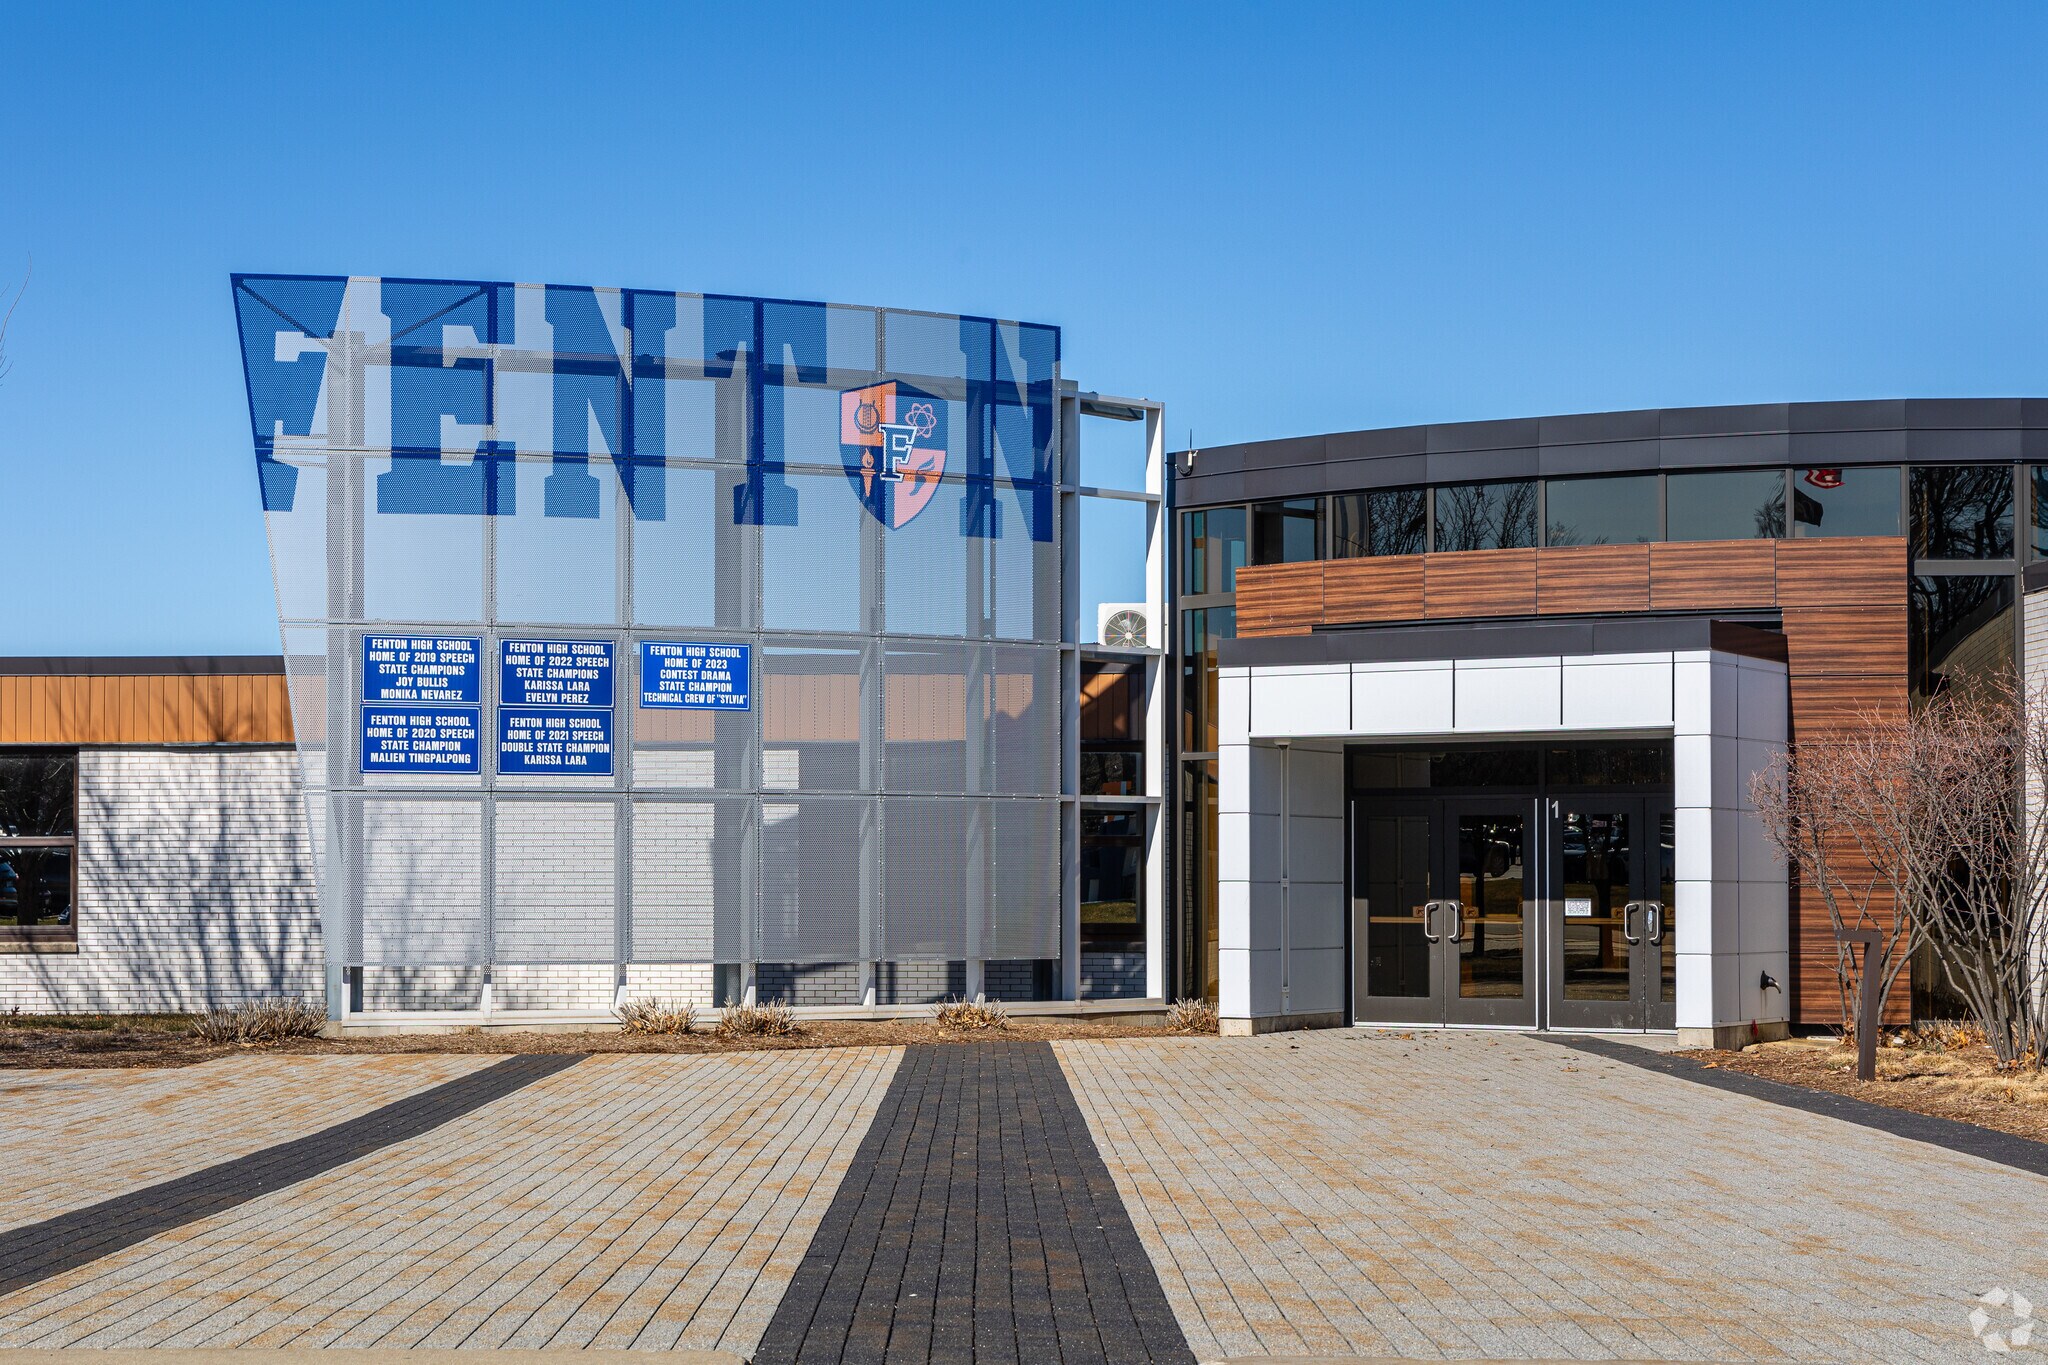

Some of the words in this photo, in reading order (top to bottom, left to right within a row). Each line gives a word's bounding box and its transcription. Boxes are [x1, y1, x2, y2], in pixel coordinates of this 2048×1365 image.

[230, 273, 1061, 543] FENTN
[879, 423, 917, 482] F
[372, 638, 407, 649] FENTON
[411, 639, 432, 650] HIGH
[436, 640, 472, 651] SCHOOL
[509, 642, 543, 653] FENTON
[547, 643, 568, 653] HIGH
[571, 644, 605, 655] SCHOOL
[369, 651, 395, 661] HOME
[399, 651, 410, 661] OF
[414, 652, 436, 662] 2019
[440, 652, 474, 663] SPEECH
[650, 646, 682, 656] FENTON
[686, 646, 705, 656] HIGH
[709, 647, 741, 657] SCHOOL
[506, 655, 530, 665] HOME
[534, 655, 545, 665] OF
[549, 656, 572, 666] 2022
[576, 657, 609, 667] SPEECH
[664, 657, 688, 667] HOME
[691, 658, 702, 668] OF
[705, 659, 727, 669] 2023
[379, 663, 407, 674] STATE
[411, 664, 464, 675] CHAMPIONS
[516, 667, 543, 677] STATE
[547, 668, 598, 679] CHAMPIONS
[660, 669, 698, 679] CONTEST
[701, 670, 731, 680] DRAMA
[395, 676, 413, 686] JOY
[417, 677, 448, 687] BULLIS
[524, 680, 563, 690] KARISSA
[567, 681, 590, 691] LARA
[659, 680, 685, 691] STATE
[688, 681, 732, 692] CHAMPION
[381, 688, 417, 699] MONIKA
[421, 689, 462, 700] NEVAREZ
[526, 692, 557, 702] EVELYN
[561, 693, 588, 703] PEREZ
[644, 692, 682, 702] TECHNICAL
[685, 693, 705, 703] CREW
[706, 694, 715, 703] OF
[716, 694, 746, 704] "SYLVIA"
[371, 715, 406, 725] FENTON
[410, 715, 431, 725] HIGH
[435, 716, 470, 726] SCHOOL
[510, 717, 542, 727] FENTON
[545, 718, 565, 727] HIGH
[569, 718, 601, 728] SCHOOL
[367, 727, 393, 737] HOME
[397, 727, 408, 737] OF
[412, 728, 436, 738] 2020
[440, 728, 474, 739] SPEECH
[507, 729, 531, 740] HOME
[535, 730, 545, 740] OF
[549, 730, 568, 740] 2021
[572, 730, 603, 740] SPEECH
[381, 740, 409, 750] STATE
[413, 740, 460, 751] CHAMPION
[502, 742, 533, 752] DOUBLE
[537, 742, 562, 752] STATE
[566, 742, 609, 753] CHAMPION
[370, 752, 405, 762] MALIEN
[408, 752, 470, 763] TINGPALPONG
[524, 754, 561, 765] KARISSA
[565, 755, 587, 765] LARA
[1551, 800, 1559, 819] 1
